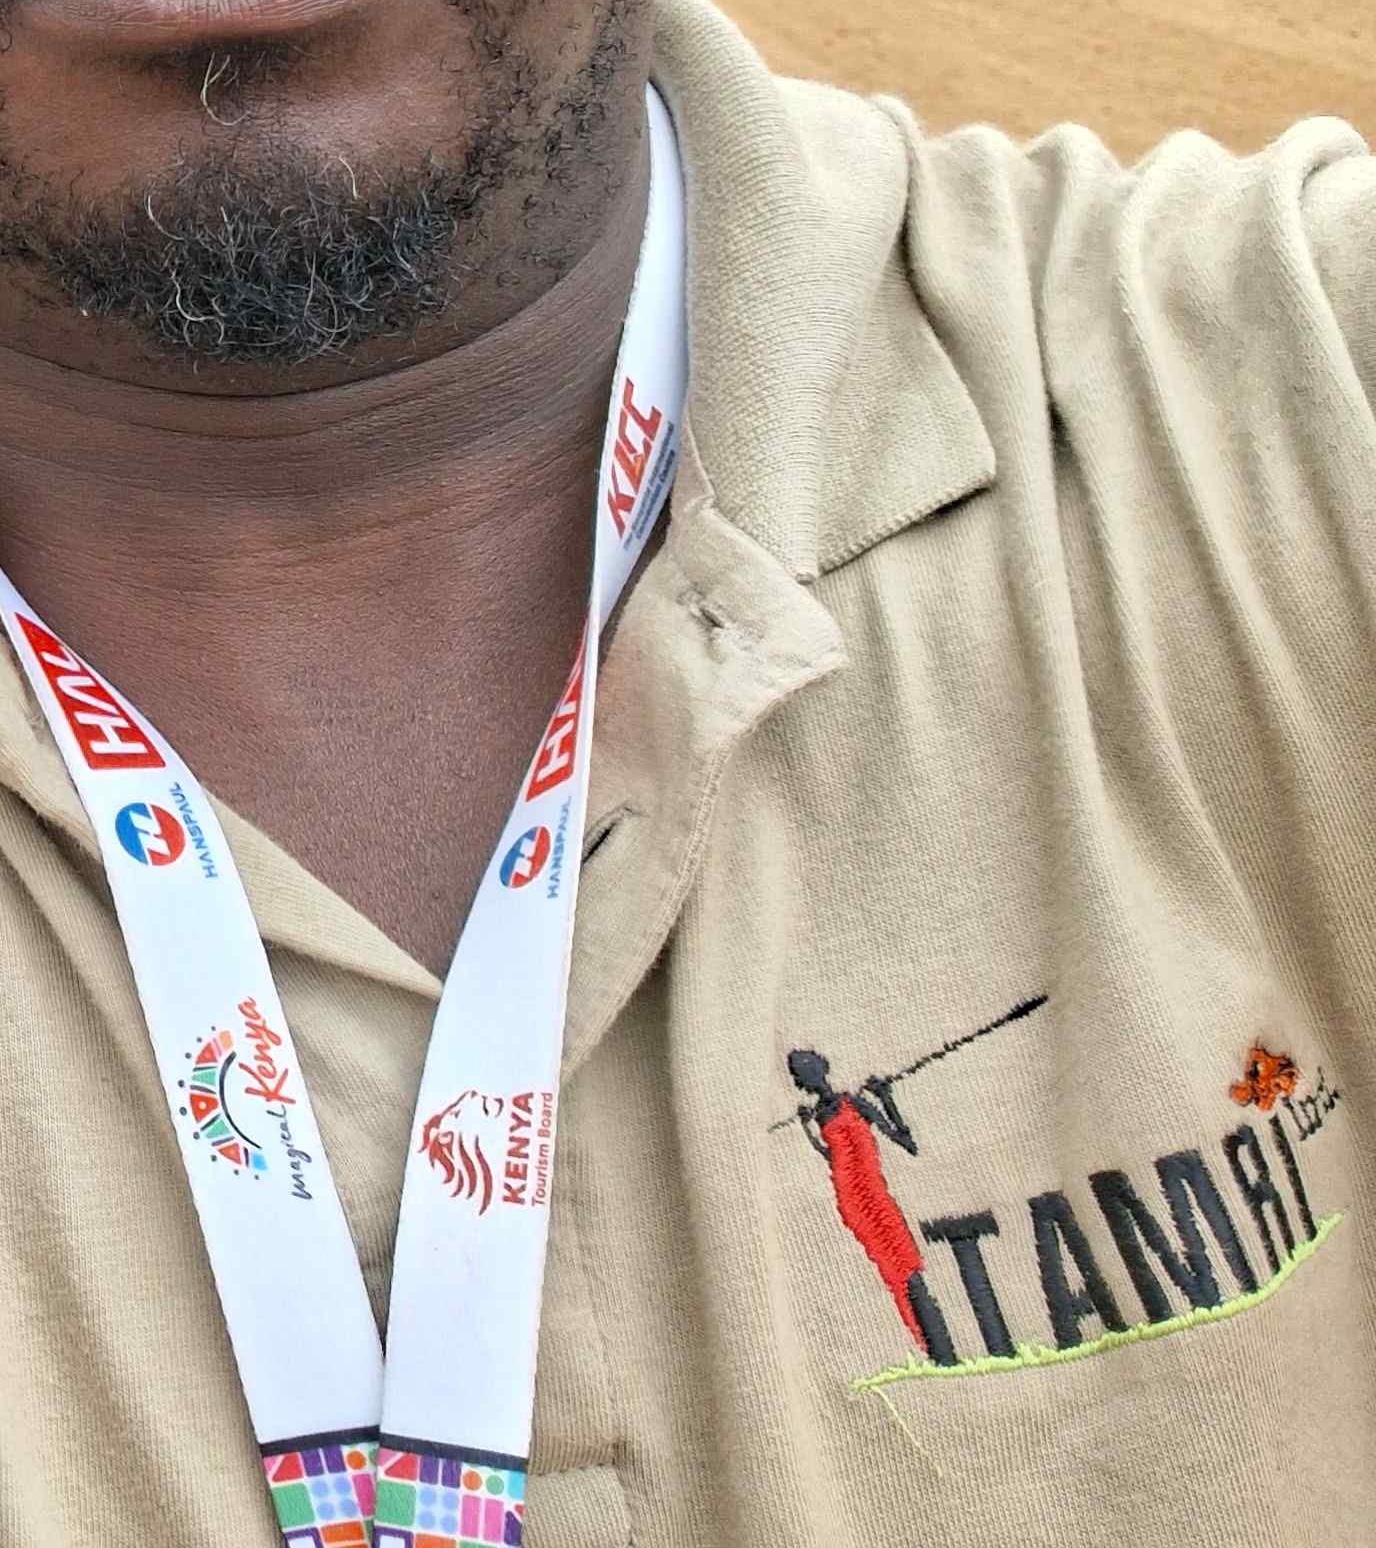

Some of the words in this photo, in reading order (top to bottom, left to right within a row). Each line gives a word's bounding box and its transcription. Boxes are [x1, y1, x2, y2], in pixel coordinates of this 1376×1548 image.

[166, 781, 220, 879] HANSPAUL
[237, 995, 297, 1105] Kenya
[266, 1104, 313, 1201] magical
[502, 1092, 534, 1205] KENYA
[537, 1092, 553, 1138] Board
[531, 1144, 550, 1207] Tourism
